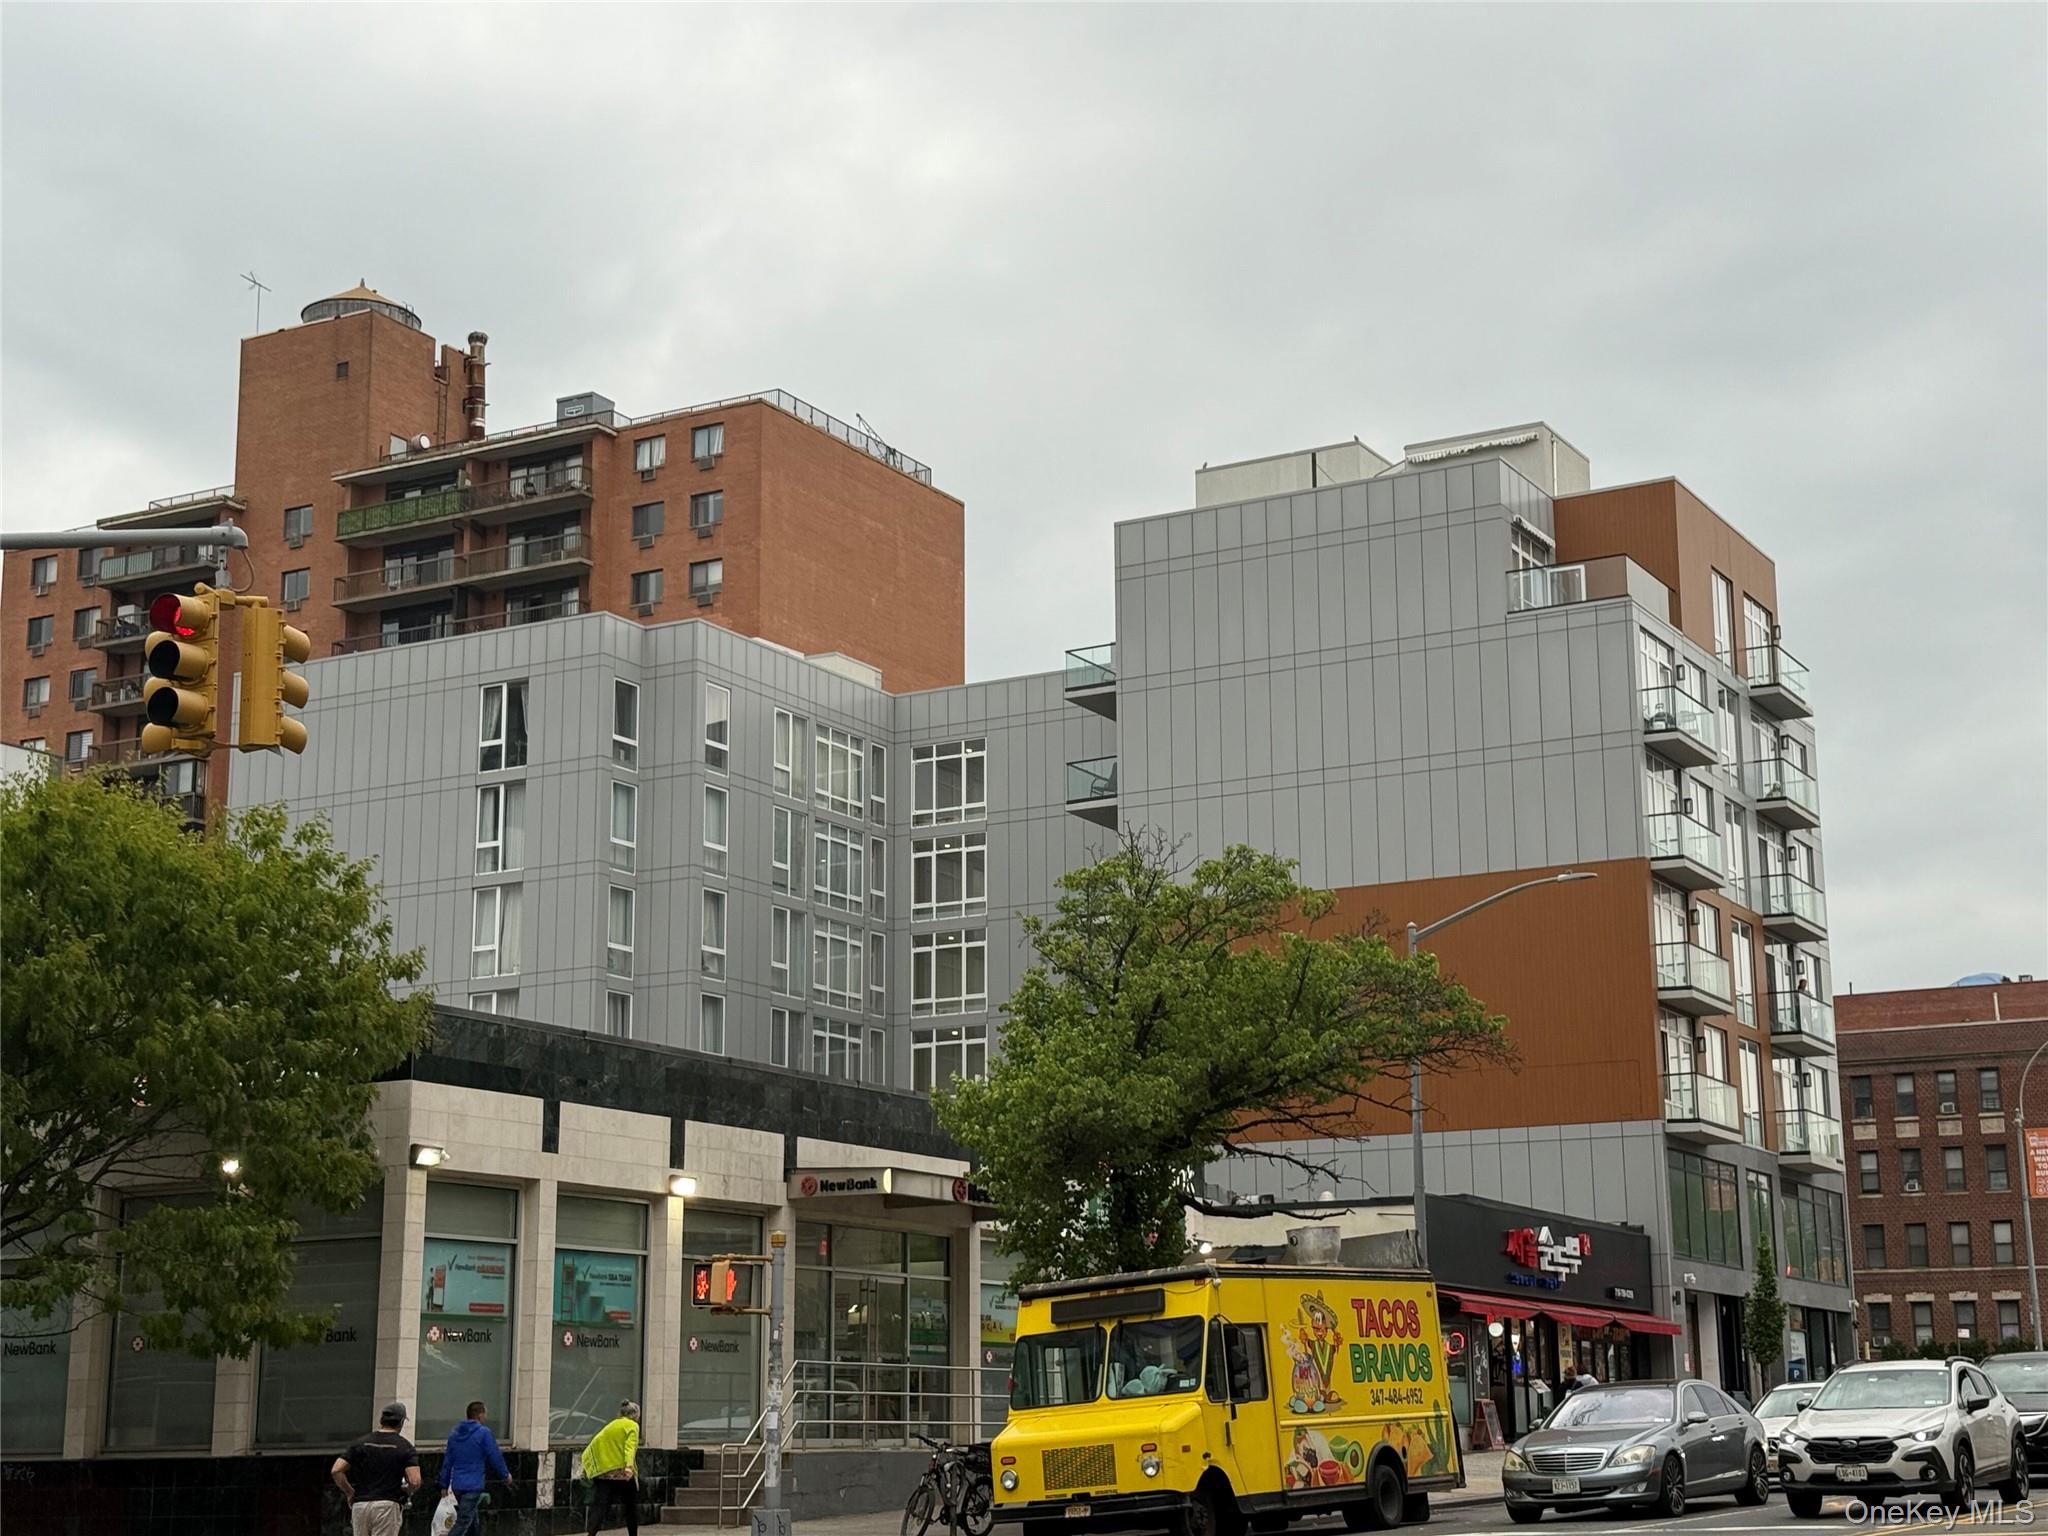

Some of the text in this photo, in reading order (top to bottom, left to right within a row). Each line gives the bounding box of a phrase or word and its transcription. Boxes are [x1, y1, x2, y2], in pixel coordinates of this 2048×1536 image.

[820, 1177, 877, 1192] NewBank
[1351, 1298, 1421, 1339] TACOS
[326, 1327, 357, 1343] Bank
[443, 1328, 492, 1343] NewBank
[577, 1334, 620, 1348] NewBank
[4, 1340, 57, 1356] NewBank
[701, 1339, 740, 1353] NewBank
[1349, 1343, 1433, 1383] BRAVOS
[1370, 1388, 1424, 1406] 347-484-6952
